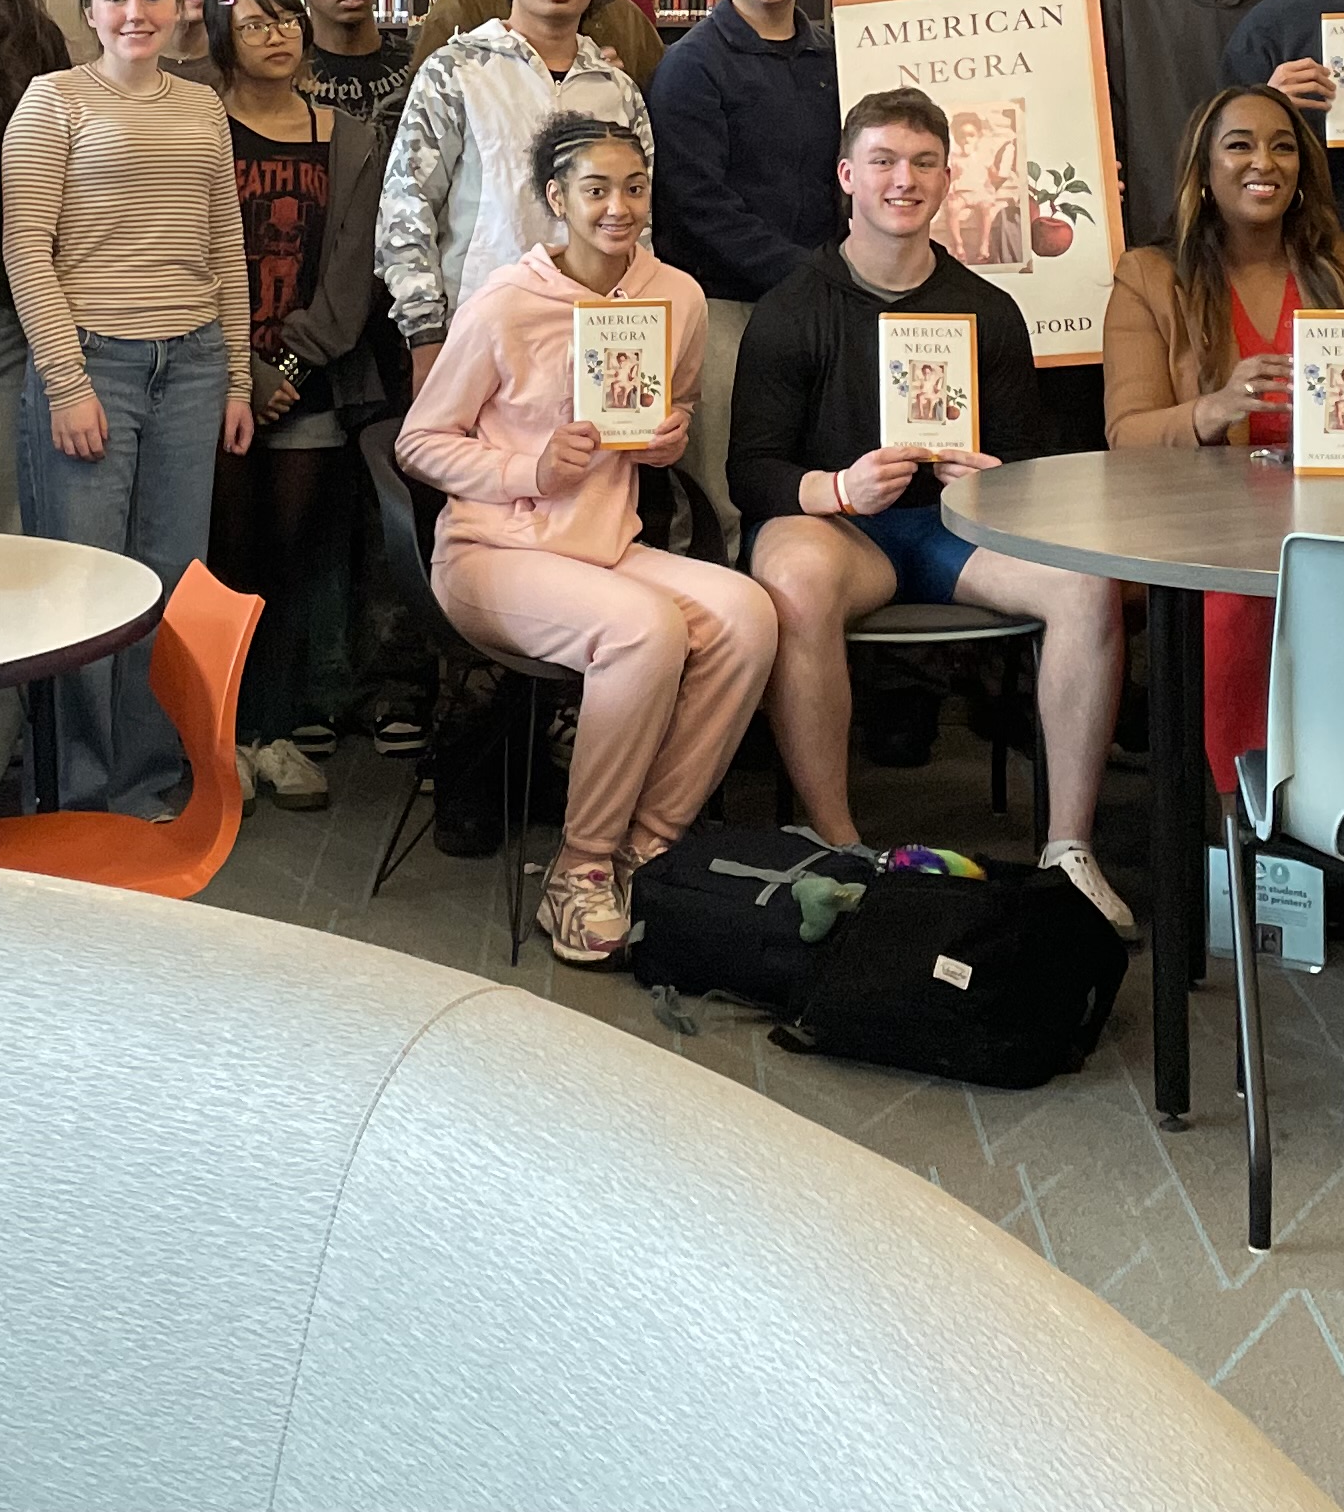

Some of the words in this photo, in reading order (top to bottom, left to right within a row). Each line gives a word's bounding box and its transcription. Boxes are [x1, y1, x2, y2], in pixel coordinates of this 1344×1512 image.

[856, 4, 1065, 49] AMERICAN
[897, 51, 1034, 88] NEGRA
[236, 159, 294, 204] EATH
[299, 160, 329, 207] RO
[587, 314, 659, 326] AMERICAN
[1030, 316, 1092, 335] FORD
[600, 331, 647, 342] NEGRA
[891, 327, 964, 338] AMERICAN
[904, 343, 952, 354] NEGRA
